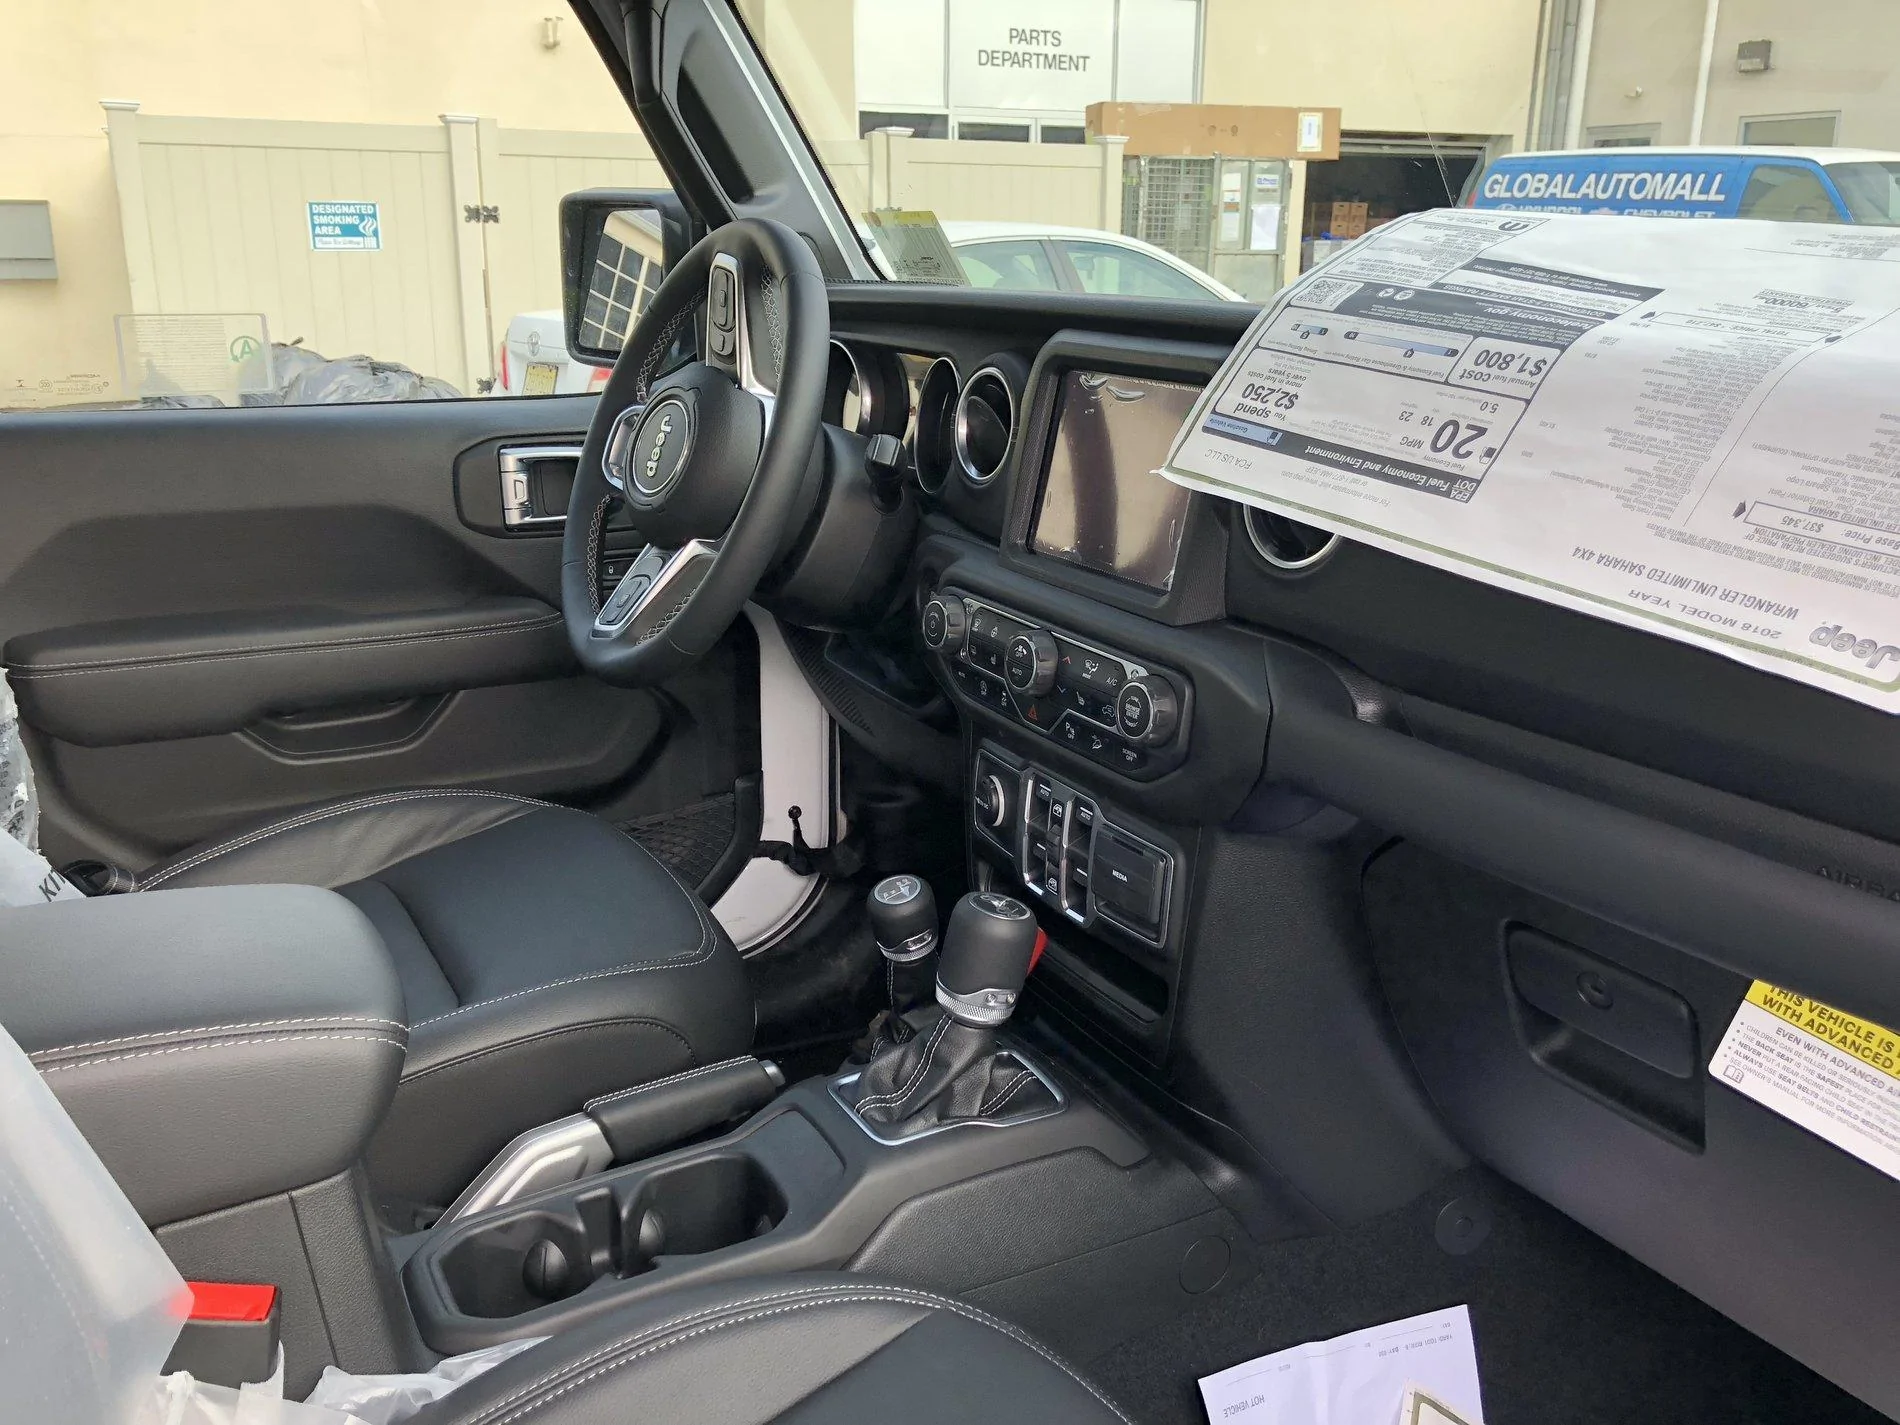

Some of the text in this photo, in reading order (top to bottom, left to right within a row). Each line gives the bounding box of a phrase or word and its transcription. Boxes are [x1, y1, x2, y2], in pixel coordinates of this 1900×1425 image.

[1009, 27, 1062, 47] PARTS
[978, 49, 1090, 72] DEPARTMENT
[1483, 172, 1726, 203] GLOBALAUTOMALL
[312, 204, 374, 214] DESIGNATED
[313, 215, 359, 224] SMOKING
[315, 226, 342, 235] AREA
[1444, 284, 1478, 297] RATINGS
[1483, 307, 1592, 329] fueleconomy.gov
[1542, 302, 1606, 317] GOVERNMENT
[1344, 352, 1360, 363] Rating
[1362, 357, 1370, 365] Gas
[1372, 359, 1401, 372] Greenhouse
[1474, 348, 1547, 378] $1,800
[1248, 370, 1302, 389] more in fuel costs
[1268, 367, 1306, 382] over 5 years
[1408, 364, 1431, 376] Economy
[1432, 370, 1444, 378] Fuel
[1458, 368, 1536, 389] Annual fuel cost
[1242, 382, 1298, 410] $2,250
[1233, 402, 1286, 422] You spend
[1480, 401, 1498, 414] 5.0
[1210, 418, 1248, 434] Gasoline Vehicle
[1398, 410, 1434, 426] 18 23
[646, 413, 673, 478] Jeep
[1400, 436, 1424, 449] MPG
[1430, 419, 1488, 460] 20
[1204, 448, 1252, 470] FCA US LLC
[1304, 444, 1450, 492] Fuel Economy and Environment
[1423, 454, 1466, 472] Fuel Economy
[1454, 478, 1476, 492] DOT
[1785, 476, 1804, 487] Logo
[1805, 480, 1830, 492] Sahara
[1363, 494, 1379, 504] more
[1450, 488, 1471, 501] EPA
[1768, 488, 1786, 498] Paint
[1786, 491, 1815, 505] Exterior
[1380, 498, 1390, 508] For
[1808, 505, 1884, 531] UNLIMITED SAHARA
[1780, 515, 1900, 550] Base Price: $37,345
[1744, 532, 1851, 564] SUGGESTED RETAIL PRICE OF
[1752, 526, 1882, 563] INCLUDING DEALER PREPARATION
[1570, 545, 1800, 620] WRANGLER UNLIMITED SAHARA 4X4
[1628, 588, 1782, 640] 2018 MODEL YEAR
[1808, 624, 1900, 670] Jeep
[1106, 677, 1118, 686] A/C
[1122, 748, 1137, 759] SCREEN
[1112, 869, 1128, 883] MEDIA
[1769, 986, 1895, 1056] THIS VEHICLE IS
[1762, 994, 1894, 1070] WITH ADVANCED
[1742, 1033, 1756, 1044] THE
[1755, 1040, 1776, 1054] BACK
[1776, 1051, 1794, 1064] SEAT
[1803, 1065, 1816, 1076] THE
[1816, 1072, 1844, 1090] SAFEST
[1746, 1025, 1875, 1096] CHILDREN CAN BE KILLED OR SERIOUSLY
[1776, 1026, 1885, 1090] EVEN WITH ADVANCED
[1738, 1040, 1762, 1058] NEVER
[1762, 1054, 1775, 1064] PUT
[1782, 1064, 1800, 1078] REAR
[1800, 1074, 1825, 1094] FACING
[1825, 1084, 1846, 1104] CHILD
[1730, 1056, 1742, 1066] SEE
[1742, 1064, 1772, 1084] OWNER'S
[1772, 1080, 1800, 1102] MANUAL
[1801, 1096, 1815, 1110] FOR
[1816, 1103, 1836, 1120] MORE
[1734, 1049, 1764, 1068] ALWAYS
[1764, 1066, 1778, 1076] USE
[1778, 1073, 1796, 1086] SEAT
[1796, 1083, 1820, 1100] BELTS
[1820, 1096, 1836, 1108] AND
[1836, 1104, 1860, 1121] CHILD
[1222, 1394, 1265, 1418] HOT VEHICLE
